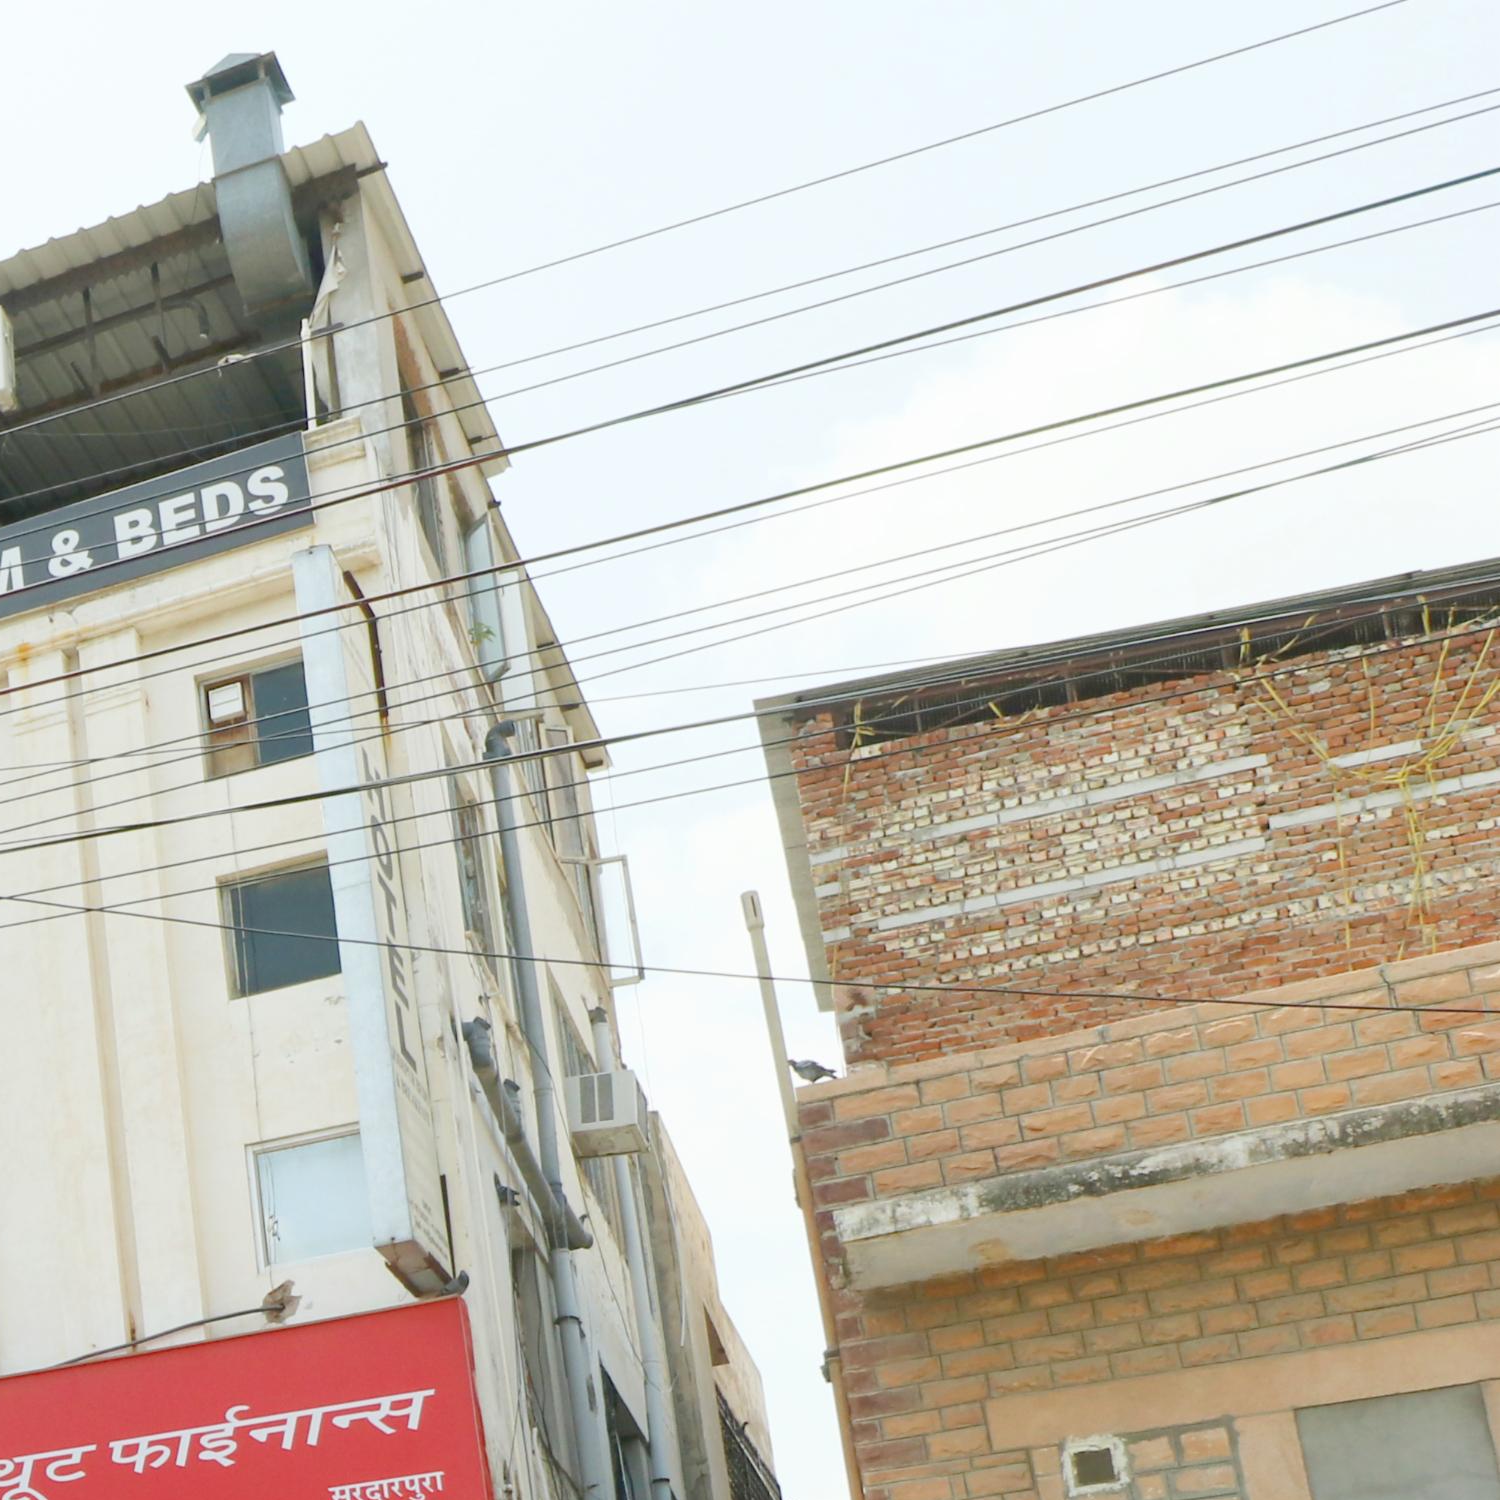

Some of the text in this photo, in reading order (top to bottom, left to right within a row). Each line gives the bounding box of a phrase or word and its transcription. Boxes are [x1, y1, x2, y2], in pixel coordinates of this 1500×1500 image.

[47, 528, 94, 579] &
[113, 465, 290, 560] BEDS
[108, 1386, 436, 1476] फाईनान्स
